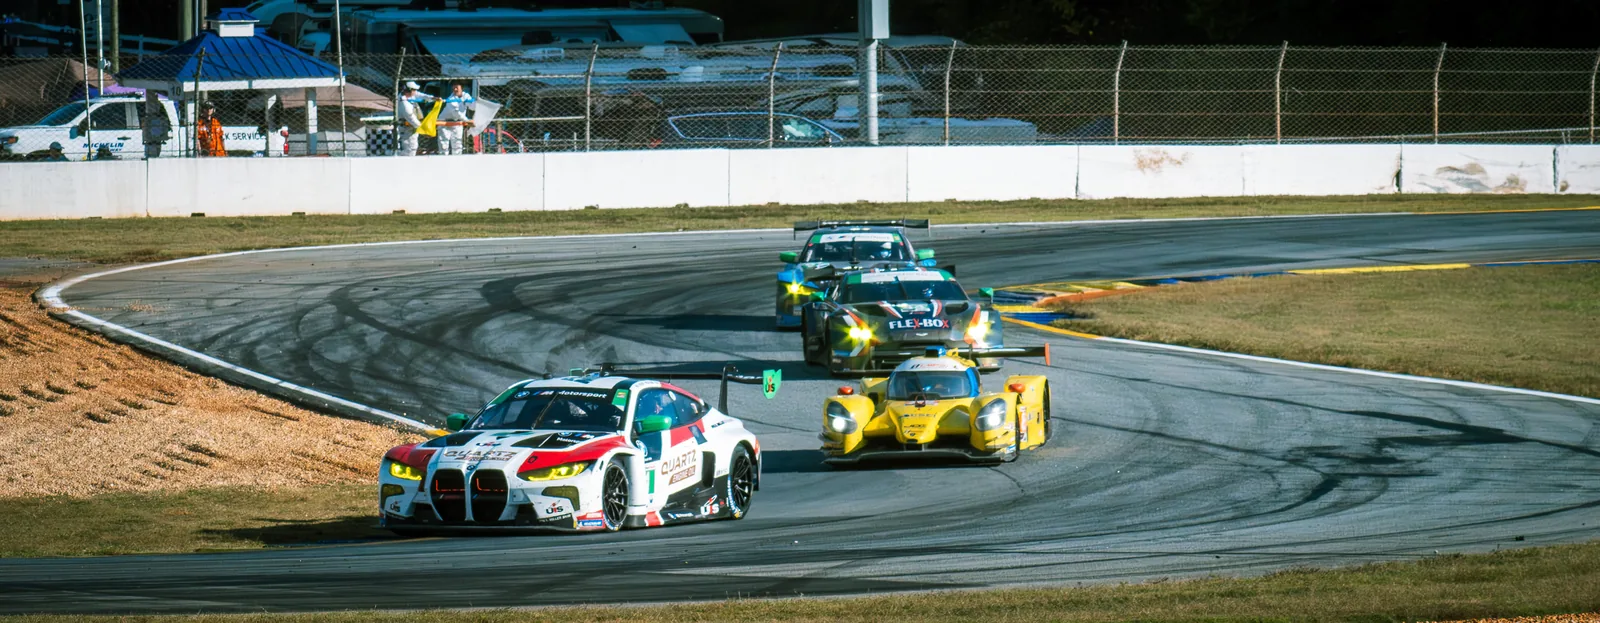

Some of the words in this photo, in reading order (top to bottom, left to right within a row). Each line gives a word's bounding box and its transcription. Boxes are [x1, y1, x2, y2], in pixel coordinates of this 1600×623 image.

[170, 85, 181, 96] 10
[889, 318, 949, 330] FLEX-BOX
[661, 449, 696, 475] QUARTZ
